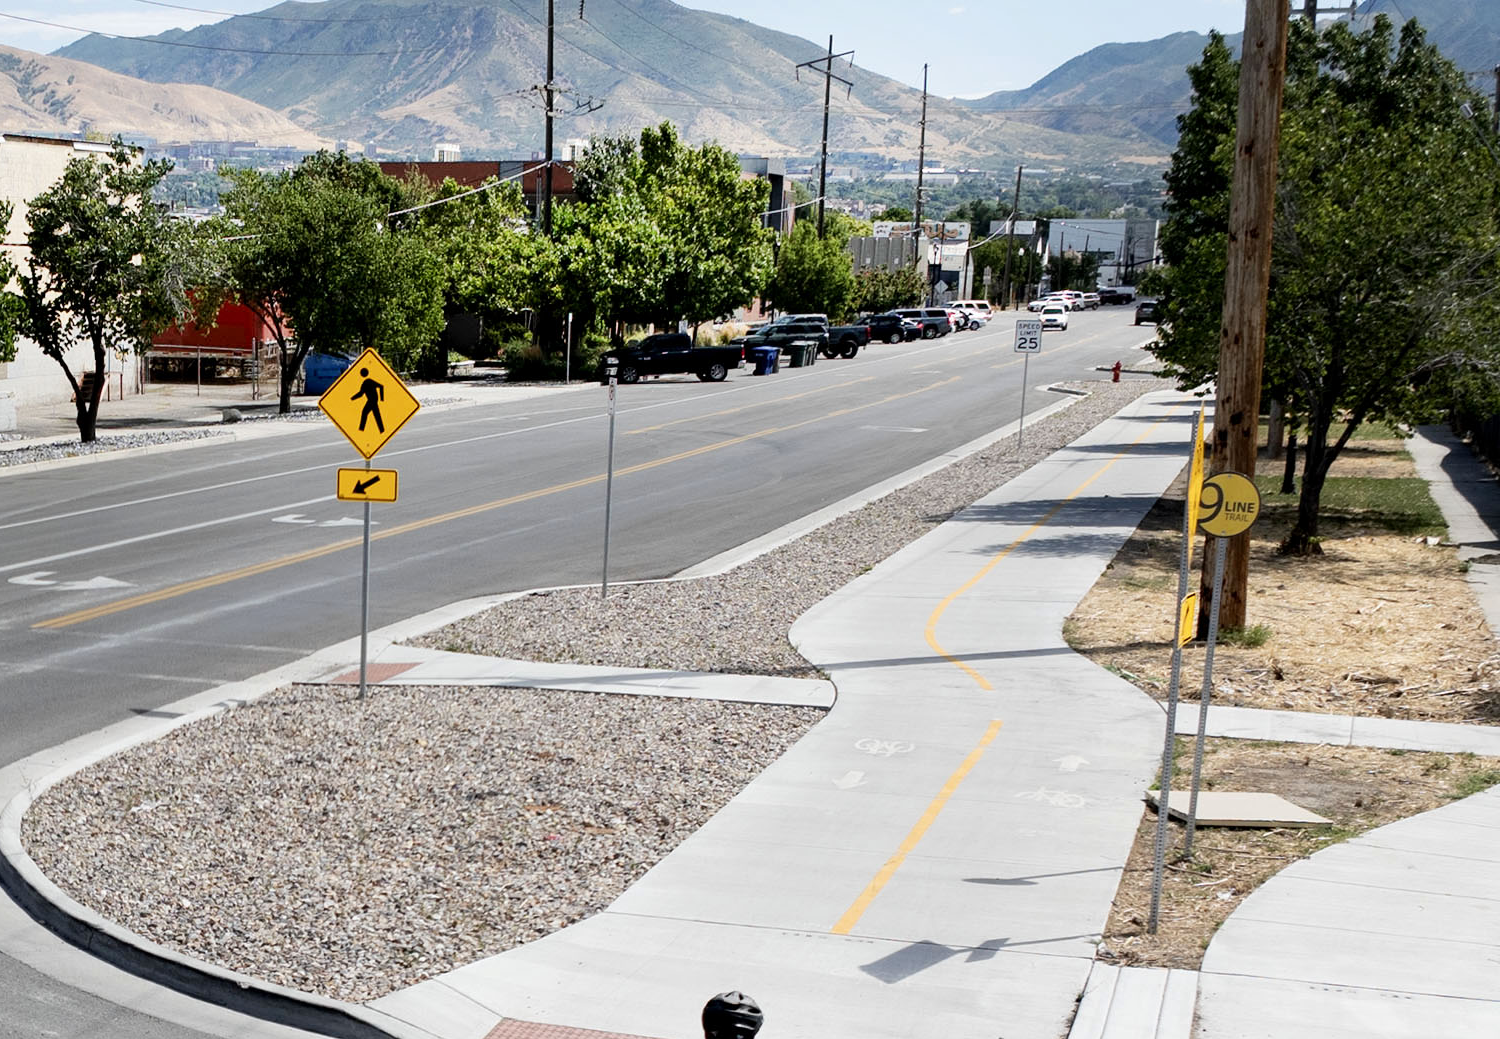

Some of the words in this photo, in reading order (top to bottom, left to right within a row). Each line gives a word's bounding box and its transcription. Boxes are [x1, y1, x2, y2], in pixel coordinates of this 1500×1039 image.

[1017, 337, 1038, 349] 25
[1197, 482, 1223, 523] 9
[1225, 502, 1255, 513] LINE
[1225, 513, 1248, 522] TRAIL
